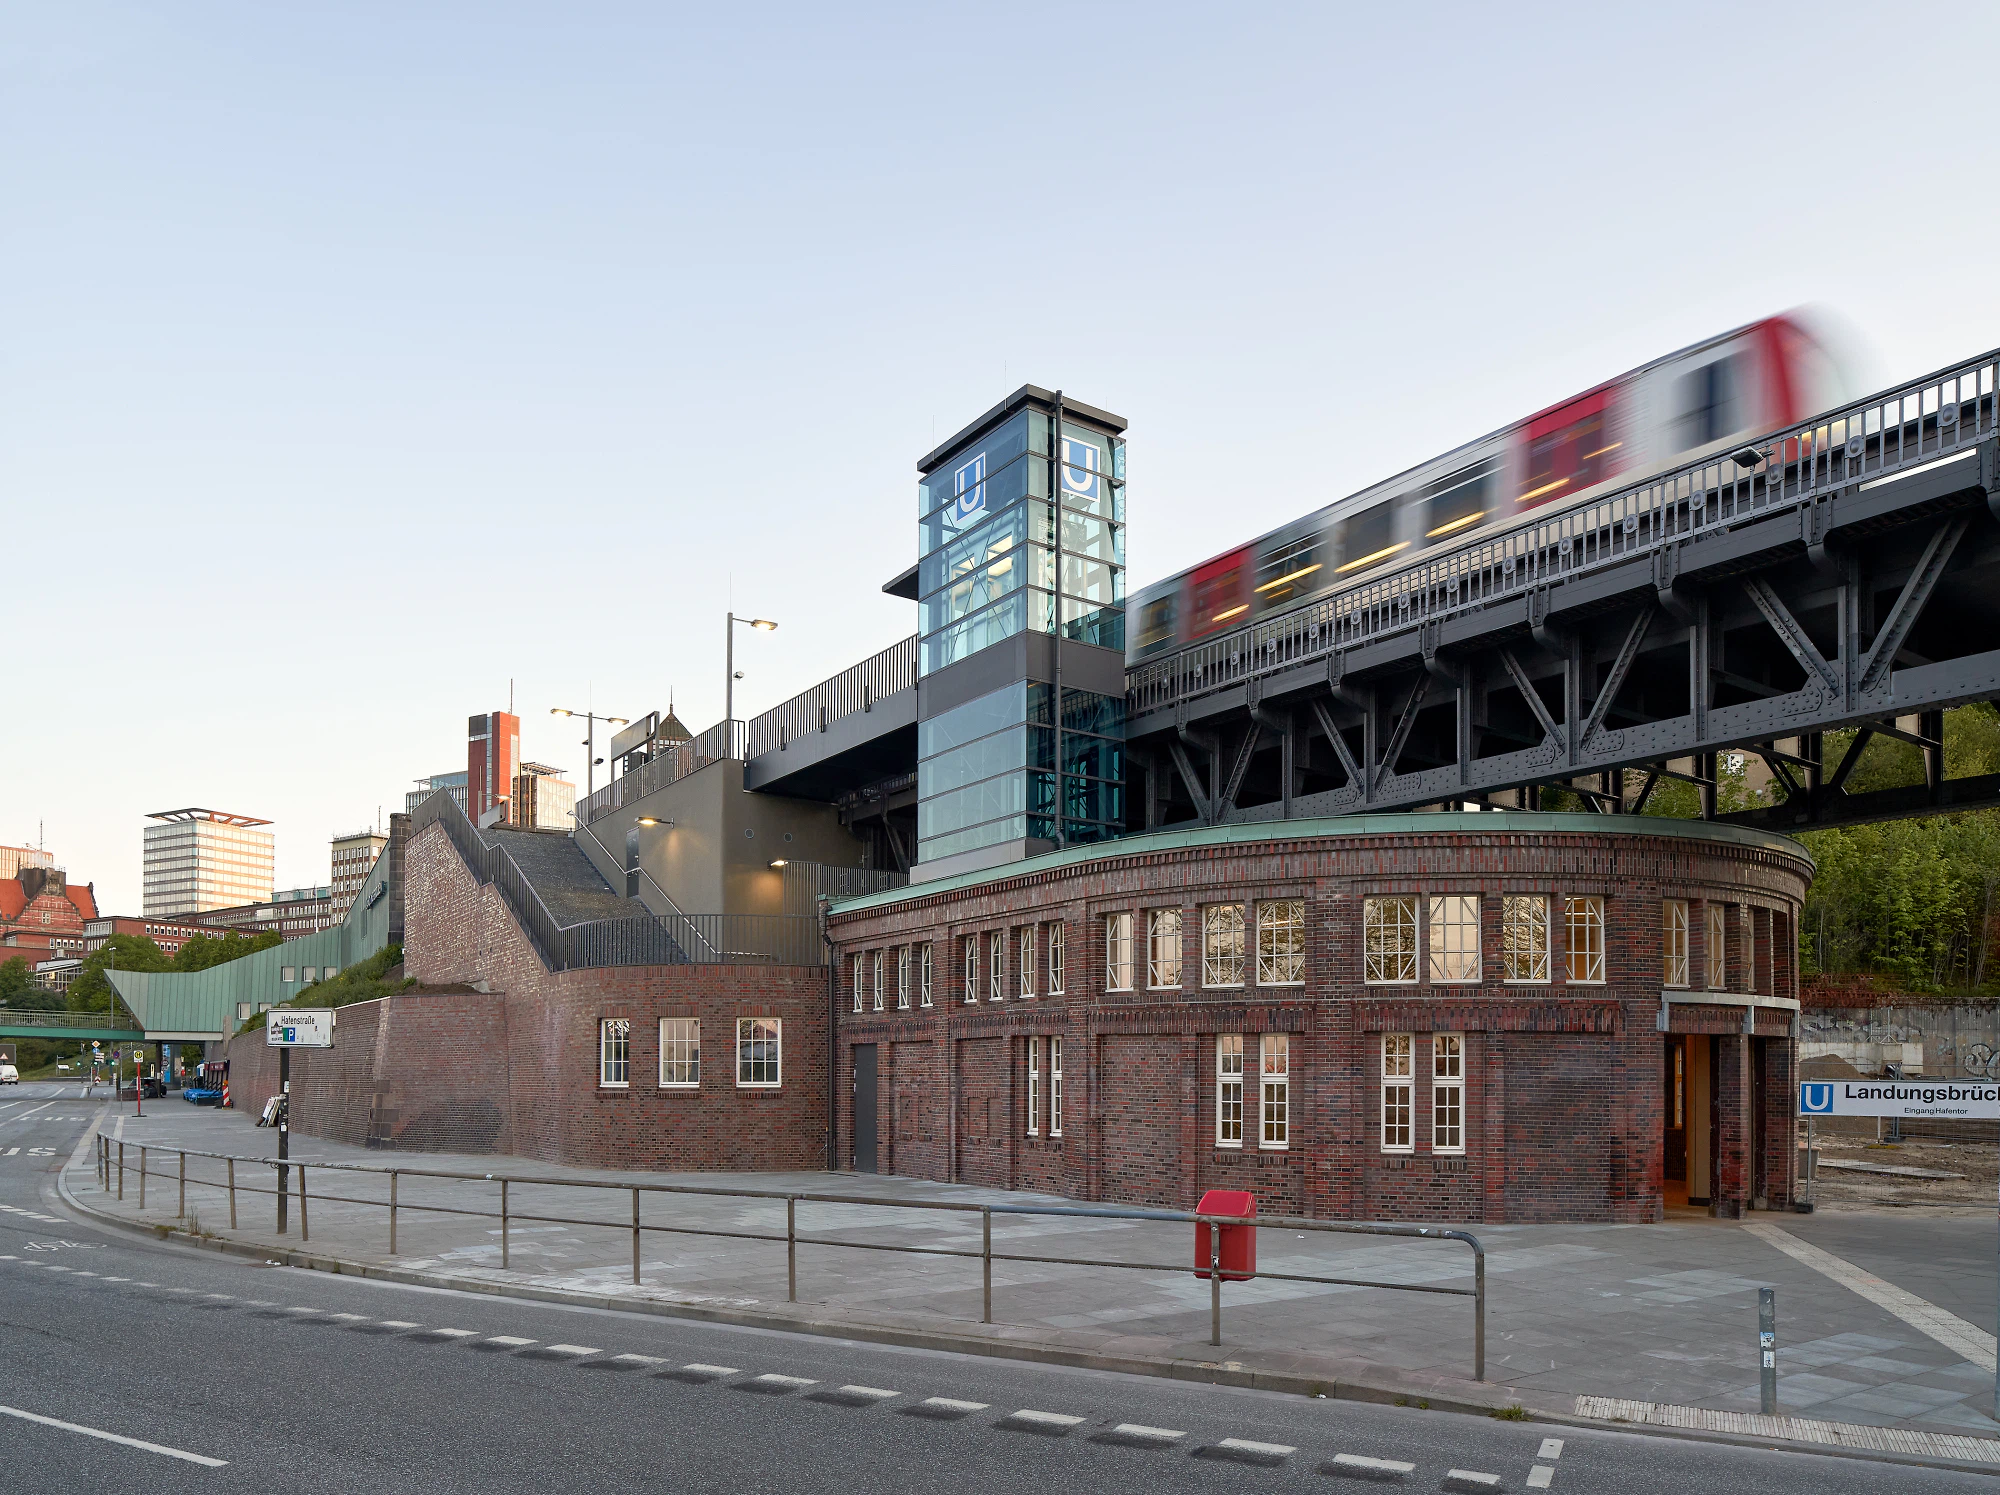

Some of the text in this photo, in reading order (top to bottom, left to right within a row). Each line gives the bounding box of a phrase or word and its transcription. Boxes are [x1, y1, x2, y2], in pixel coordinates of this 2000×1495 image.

[1062, 441, 1093, 492] U
[959, 460, 981, 513] U
[281, 1015, 316, 1026] Hafenstraße
[288, 1029, 294, 1041] P
[1805, 1084, 2000, 1111] U Landungsbrüc
[1904, 1107, 1968, 1116] Eingang Hafentor
